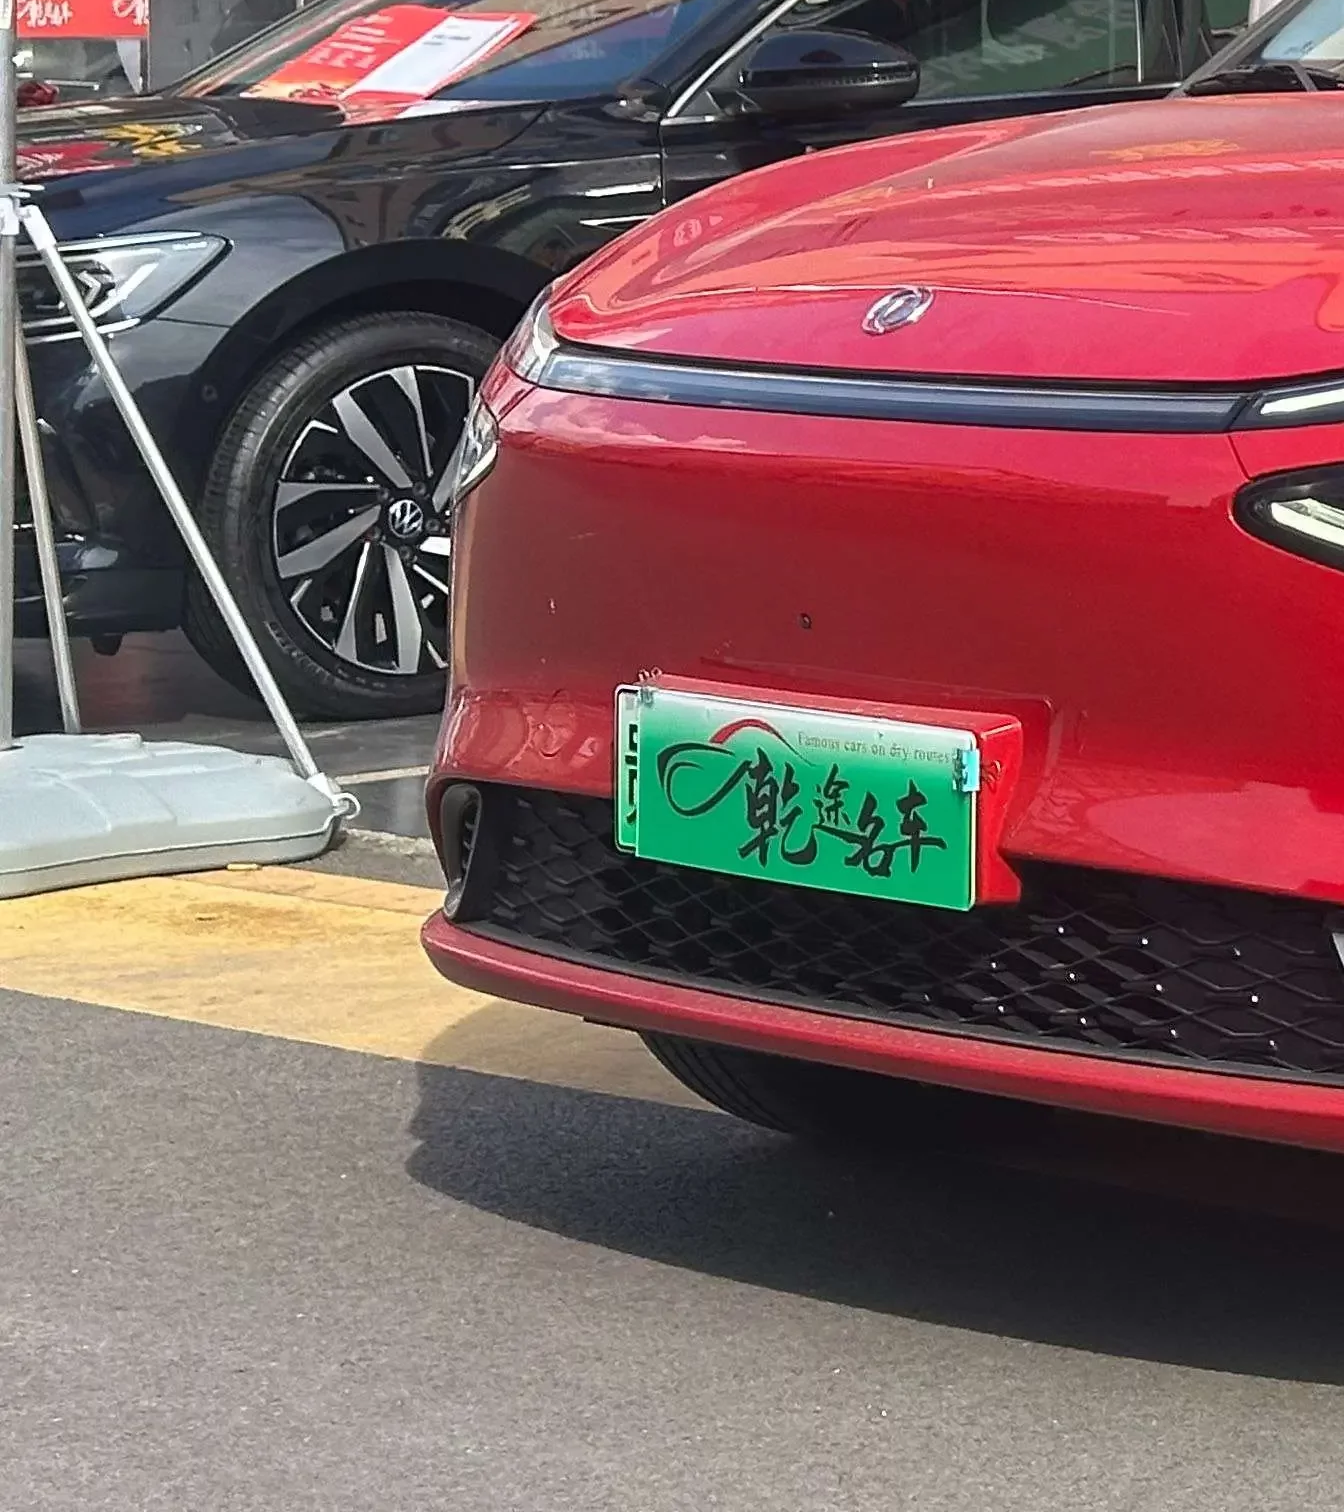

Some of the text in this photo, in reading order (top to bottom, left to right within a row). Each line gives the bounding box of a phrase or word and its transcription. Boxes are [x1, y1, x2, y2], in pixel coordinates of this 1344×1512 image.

[797, 731, 841, 749] Famous
[844, 739, 867, 753] cars
[871, 744, 886, 757] on
[889, 742, 910, 761] dry
[738, 746, 948, 878] 乾途名车
